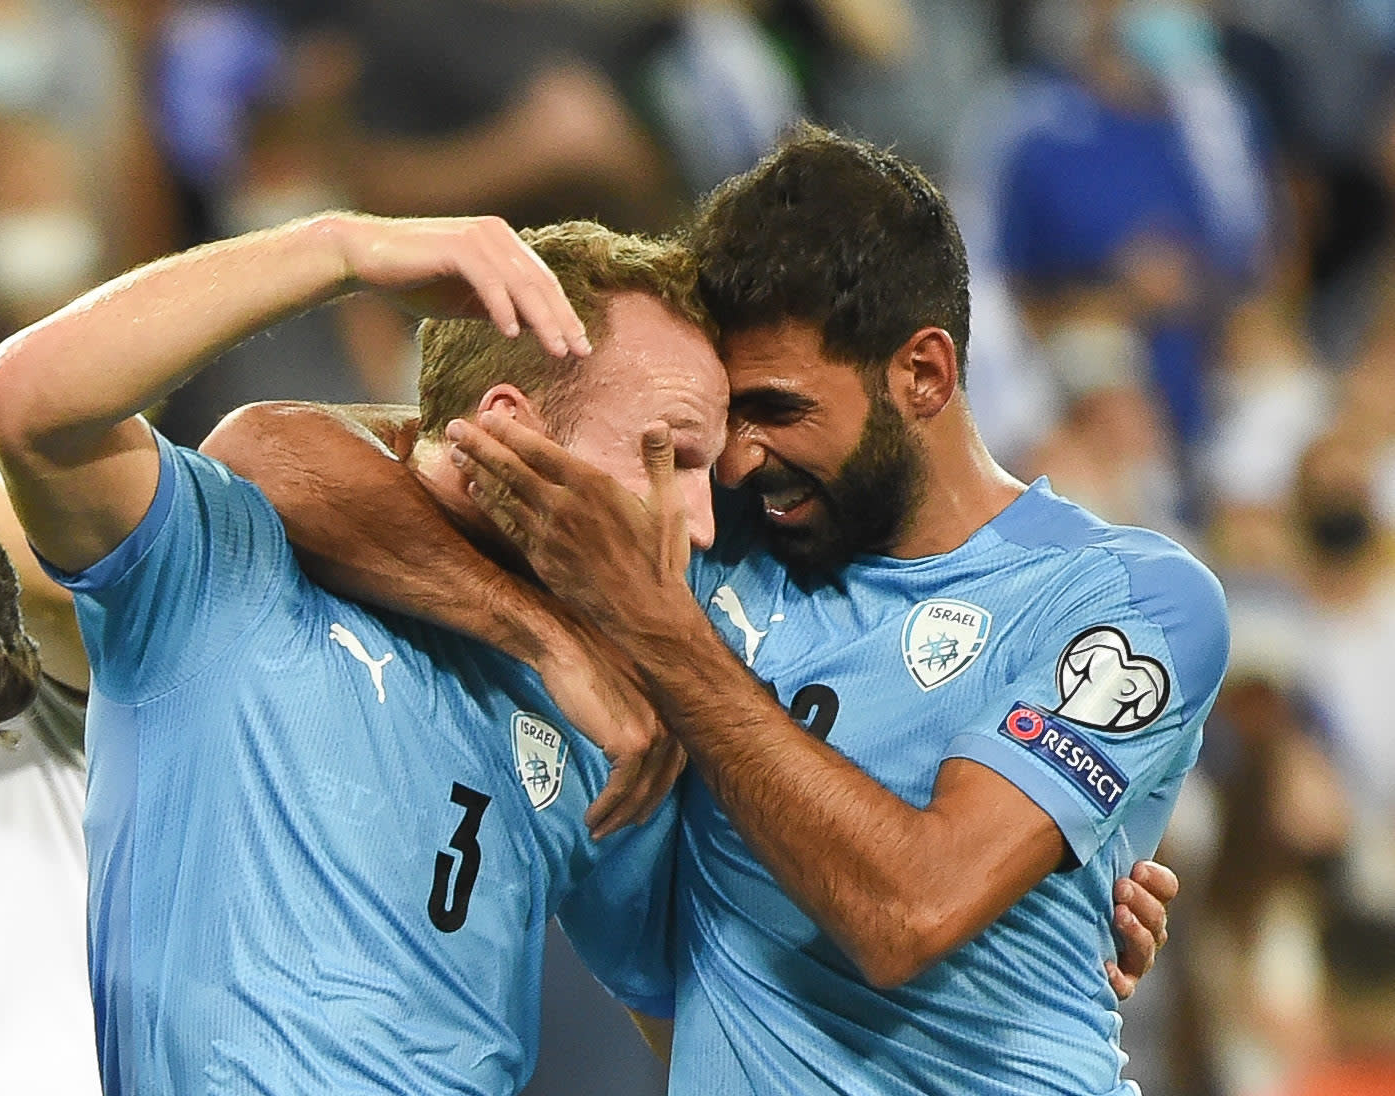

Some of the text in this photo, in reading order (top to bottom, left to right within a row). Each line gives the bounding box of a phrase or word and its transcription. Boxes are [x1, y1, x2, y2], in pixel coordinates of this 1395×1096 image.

[927, 605, 976, 628] ISRAEL
[520, 719, 557, 749] ISRAEL
[1040, 728, 1123, 804] RESPECT
[426, 780, 493, 934] 3
